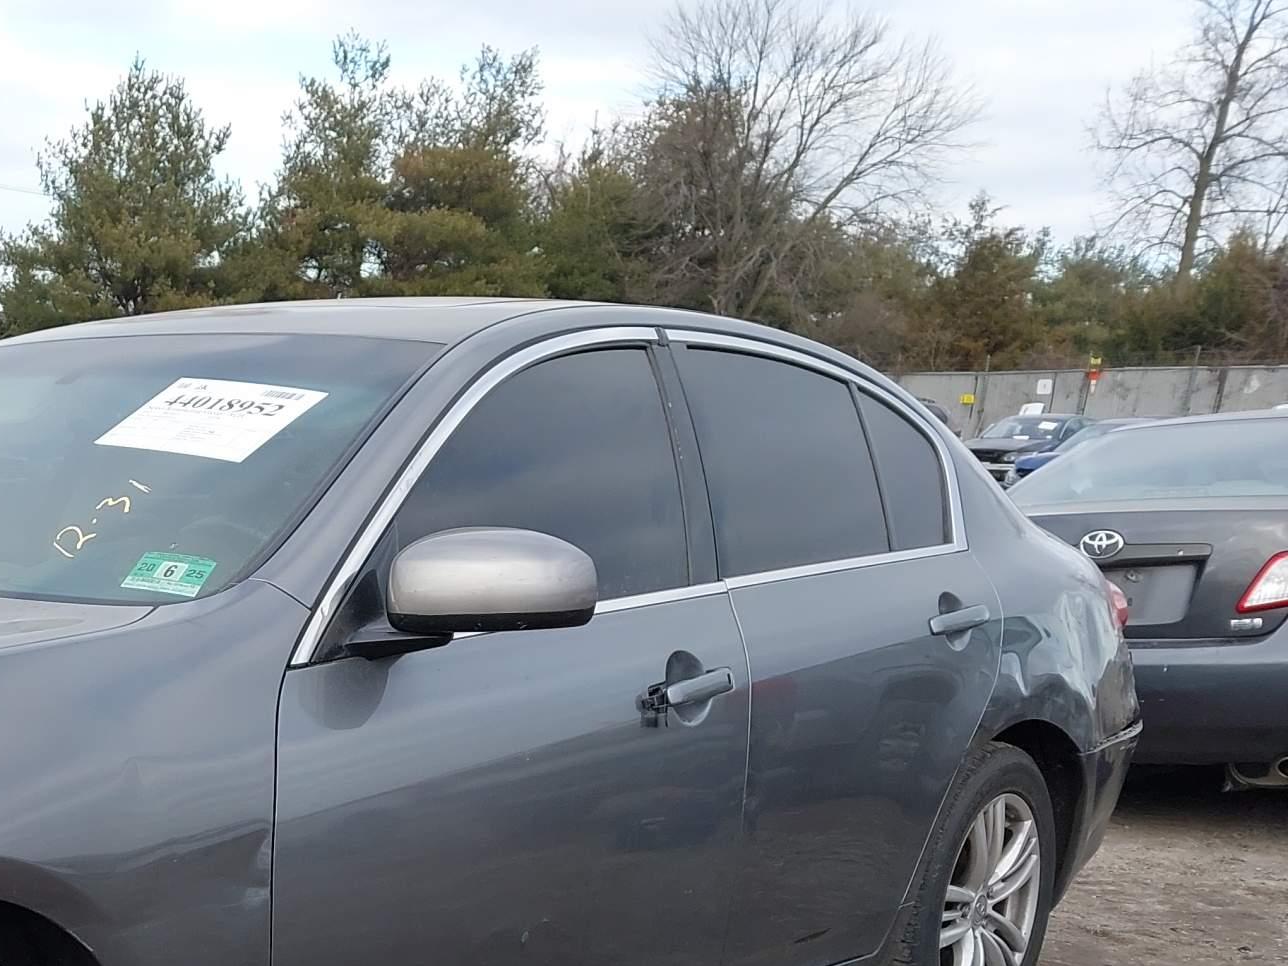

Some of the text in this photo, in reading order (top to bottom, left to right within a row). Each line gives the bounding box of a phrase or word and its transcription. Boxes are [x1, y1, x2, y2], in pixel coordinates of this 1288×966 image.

[164, 394, 285, 417] 44018952
[137, 562, 206, 579] 20 6 25
